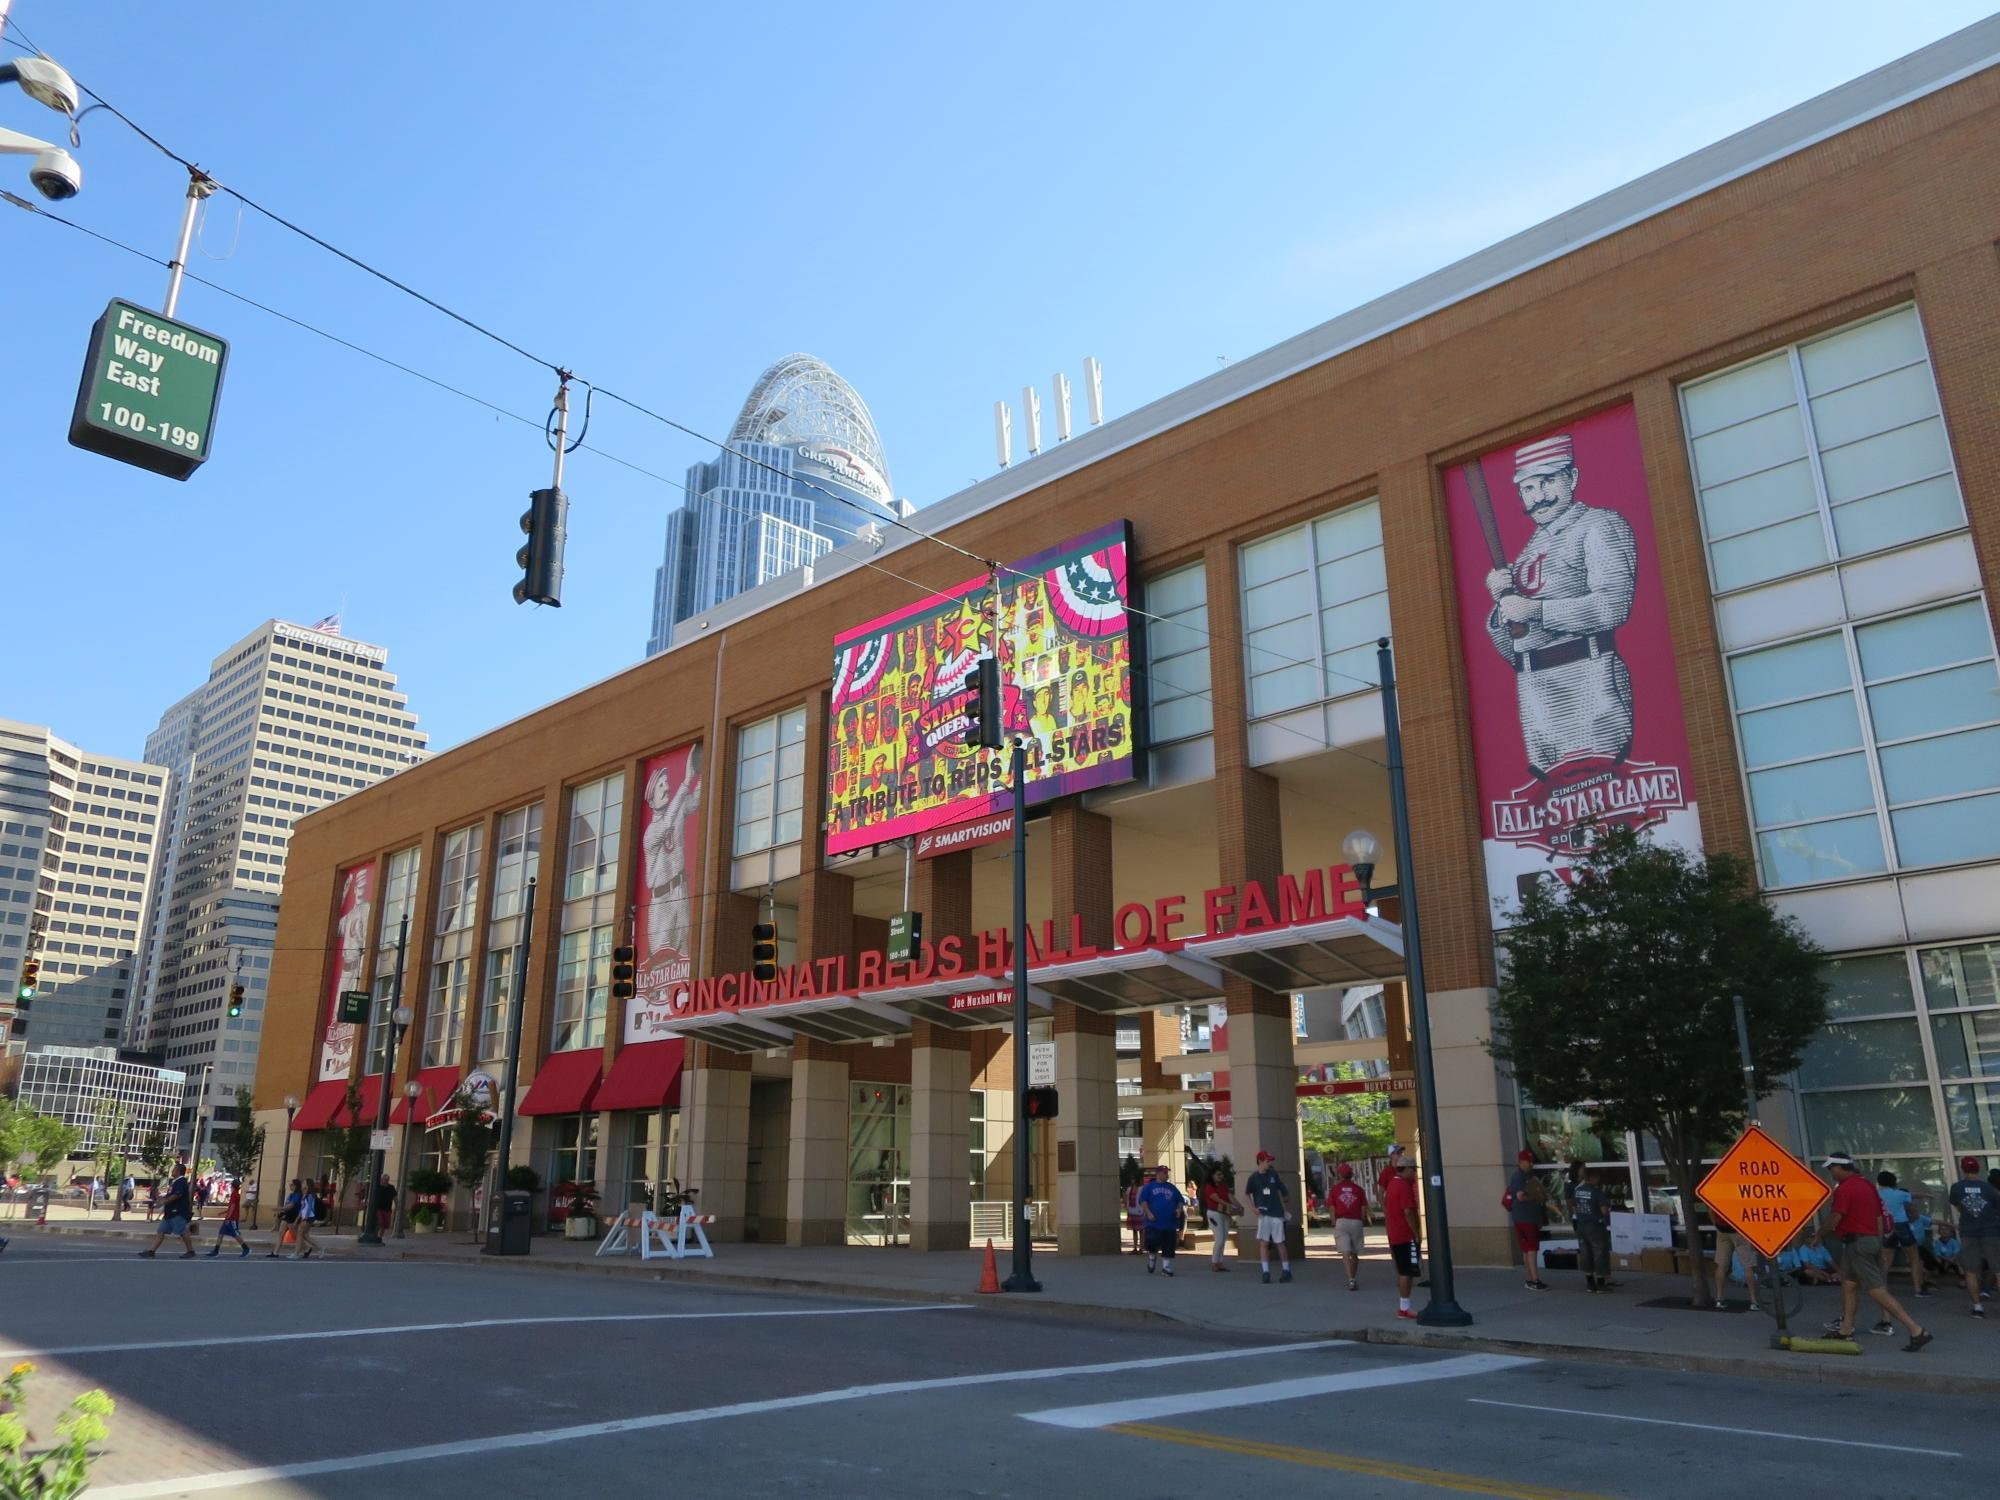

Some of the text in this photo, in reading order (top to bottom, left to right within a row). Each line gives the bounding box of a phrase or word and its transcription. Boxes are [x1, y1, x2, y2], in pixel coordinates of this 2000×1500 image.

[118, 309, 220, 365] Freedom
[113, 335, 165, 373] Way
[106, 360, 161, 397] East
[101, 402, 200, 451] 100-199
[273, 622, 385, 660] Cincinnati Bell
[834, 802, 844, 820] A
[849, 781, 918, 820] TRIBUTE
[923, 774, 946, 797] TO
[950, 757, 1002, 790] REDS
[1551, 773, 1614, 798] CINCINNATI
[1608, 774, 1677, 807] GAME
[935, 817, 1012, 849] SMARTVISION
[890, 917, 903, 927] Main
[890, 926, 905, 937] Street
[669, 863, 1366, 1016] CINCINNATI REDS HALL OF FAME
[952, 991, 1012, 1009] Joe Nuxhall Way
[1364, 1080, 1392, 1092] NUXY'S
[1739, 1161, 1780, 1176] ROAD
[1739, 1184, 1788, 1199] WORK
[1742, 1207, 1791, 1223] AHEAD
